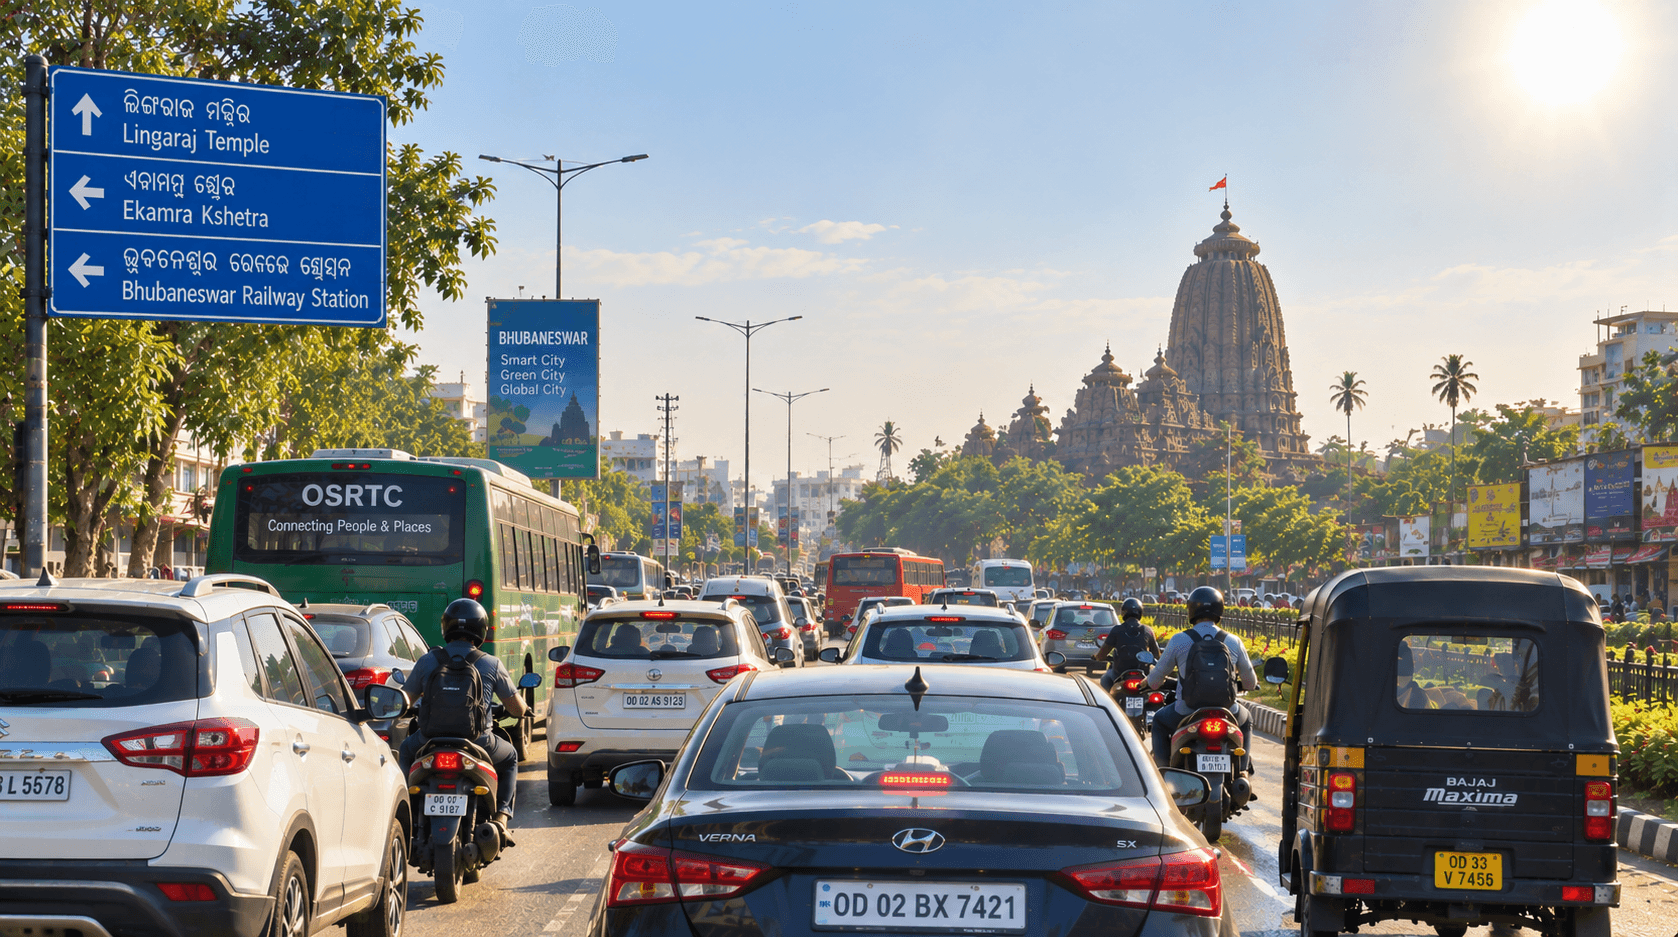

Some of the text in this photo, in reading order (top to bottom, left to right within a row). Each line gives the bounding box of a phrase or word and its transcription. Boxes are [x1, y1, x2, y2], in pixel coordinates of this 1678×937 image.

[123, 123, 270, 157] Lingaraj Temple
[123, 200, 269, 227] Ekamra Kshetra
[122, 280, 369, 311] Bhubaneswar Railway Station
[499, 331, 589, 345] BHUBANESWAR
[501, 354, 565, 368] Smart City
[500, 369, 565, 383] Green City
[500, 383, 566, 398] Global City
[302, 483, 403, 507] OSRTC
[268, 518, 432, 534] Connecting People & Places
[1446, 777, 1497, 787] BAJAJ
[1423, 788, 1518, 804] Maxima
[699, 833, 756, 842] VERNA
[1116, 840, 1137, 848] SX
[1449, 855, 1487, 870] OD 33
[1443, 870, 1453, 885] V
[833, 892, 1014, 919] OD 02 BX 7421
